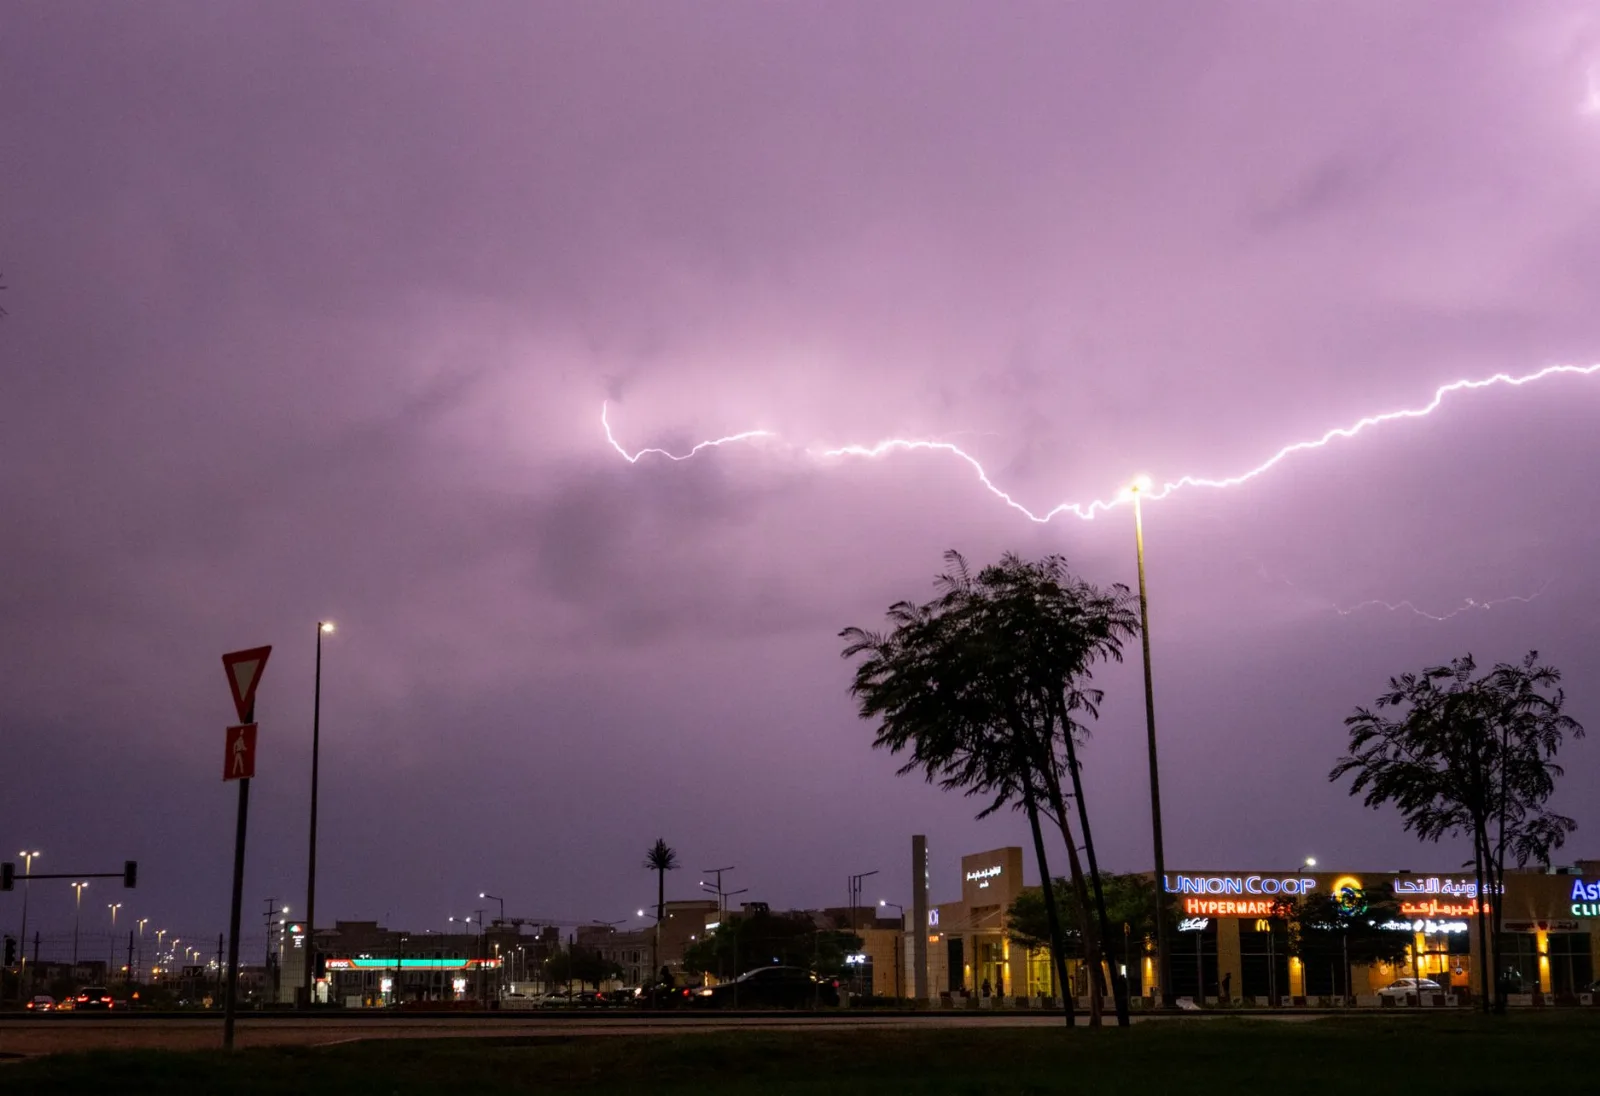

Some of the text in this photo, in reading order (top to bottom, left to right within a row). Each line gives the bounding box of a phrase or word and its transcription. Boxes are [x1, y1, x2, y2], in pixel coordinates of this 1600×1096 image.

[1164, 875, 1316, 894] UNION COOP
[1572, 904, 1600, 916] CLI
